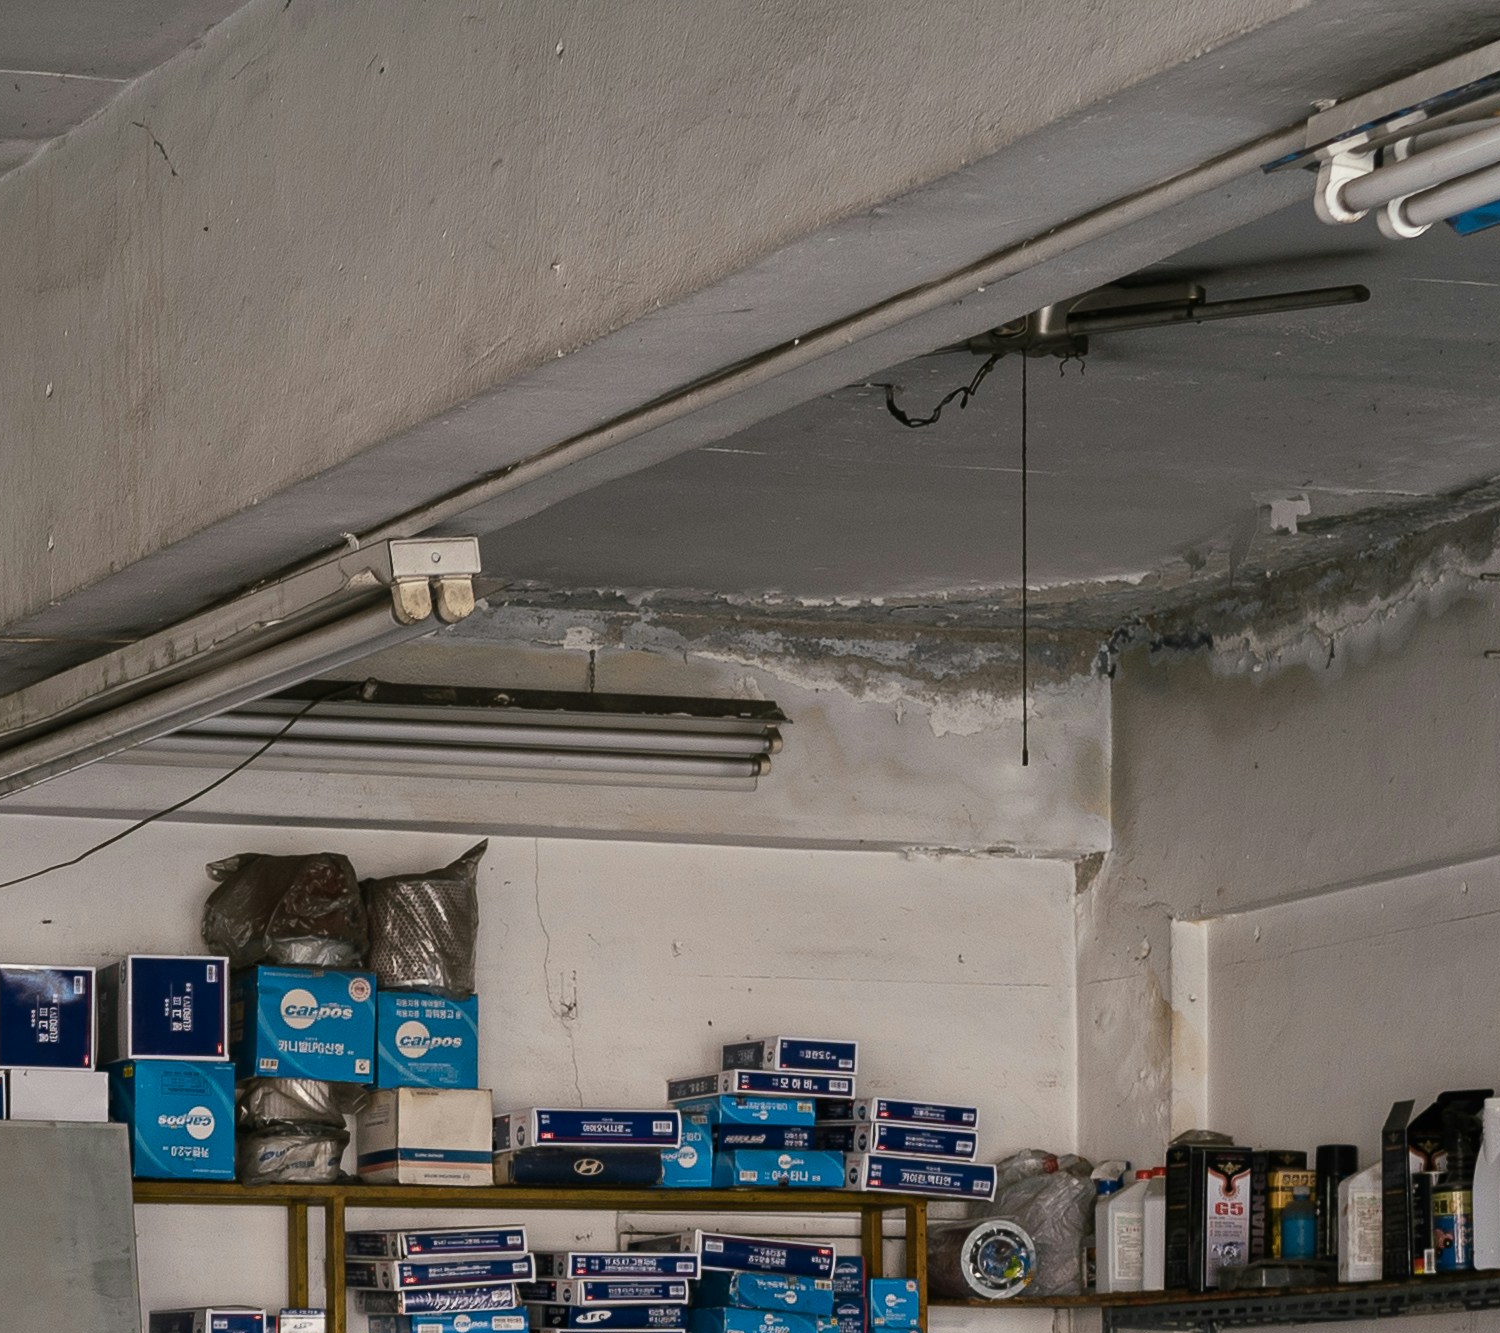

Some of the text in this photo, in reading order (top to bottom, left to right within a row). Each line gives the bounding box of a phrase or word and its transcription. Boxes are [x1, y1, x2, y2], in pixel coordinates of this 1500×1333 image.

[282, 1003, 354, 1021] carpos
[398, 1036, 463, 1049] carpos
[1214, 1201, 1245, 1216] G5
